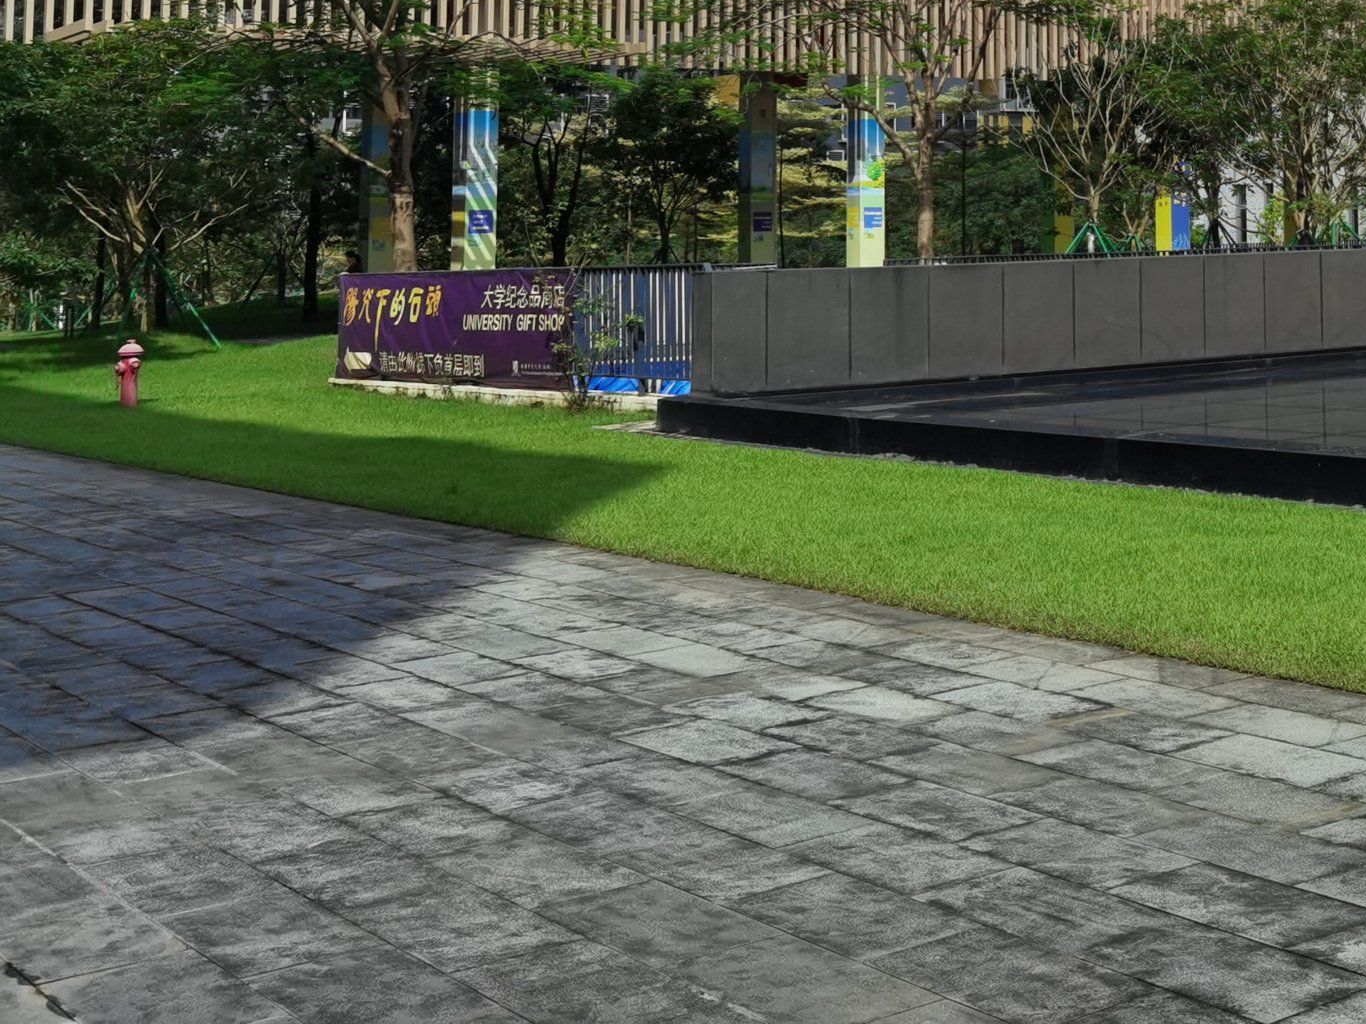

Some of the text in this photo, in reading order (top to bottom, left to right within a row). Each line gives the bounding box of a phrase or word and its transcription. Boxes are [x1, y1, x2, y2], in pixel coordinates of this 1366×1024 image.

[481, 284, 565, 309] 大学纪念品商店
[463, 314, 565, 331] UNIVERSITY GIFT SHOP
